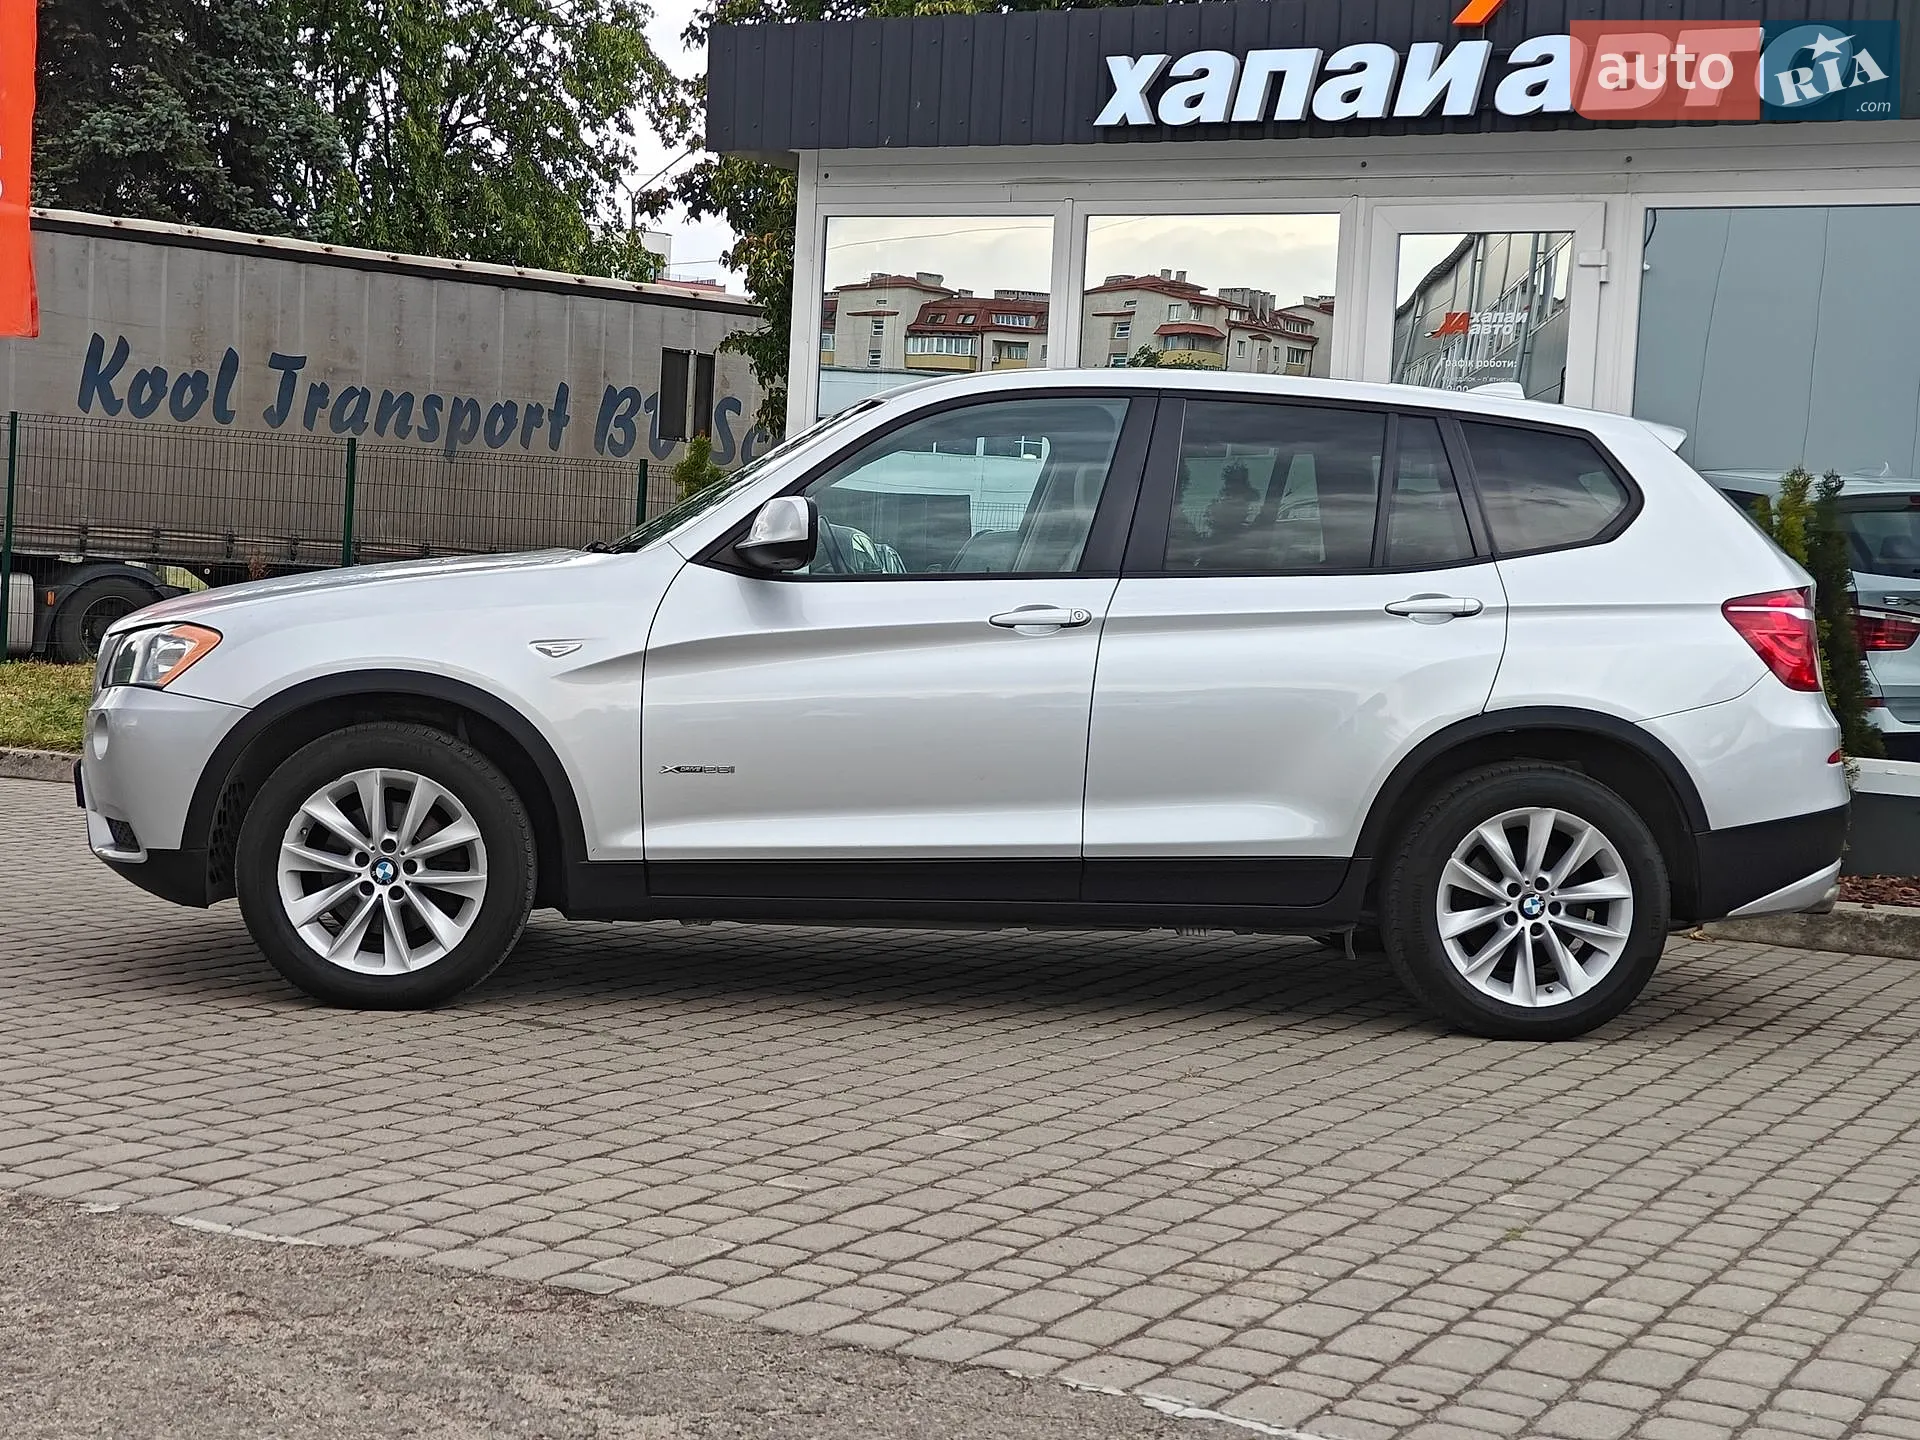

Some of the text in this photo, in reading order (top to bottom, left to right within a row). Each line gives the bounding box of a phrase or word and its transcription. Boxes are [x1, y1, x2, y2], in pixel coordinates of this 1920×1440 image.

[1093, 1, 1505, 127] хапай
[1441, 357, 1518, 369] Графік роботи:
[1469, 323, 1513, 335] авто
[78, 332, 239, 425] Kool
[263, 352, 570, 461] Transport
